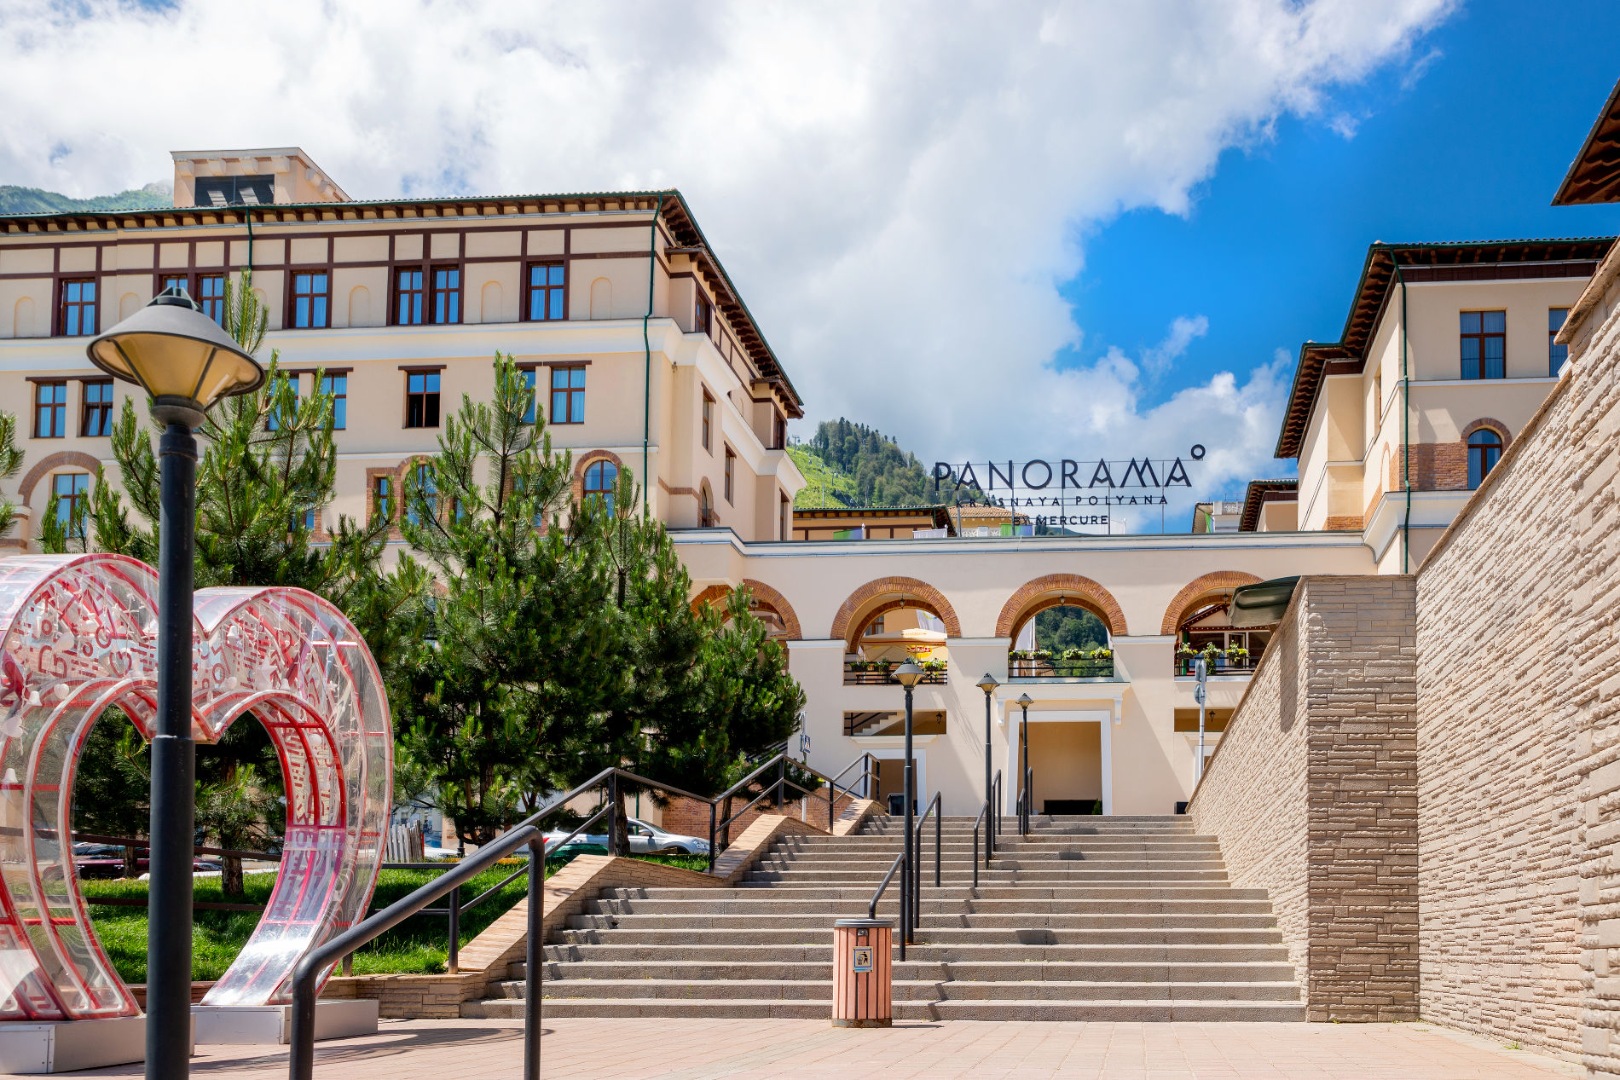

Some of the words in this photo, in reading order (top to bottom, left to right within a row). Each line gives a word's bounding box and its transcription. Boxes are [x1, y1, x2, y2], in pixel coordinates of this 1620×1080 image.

[956, 497, 1061, 508] KRASNAYA
[1075, 495, 1168, 506] POLYANA
[1013, 516, 1031, 526] BY
[1036, 515, 1109, 526] MERCURE
